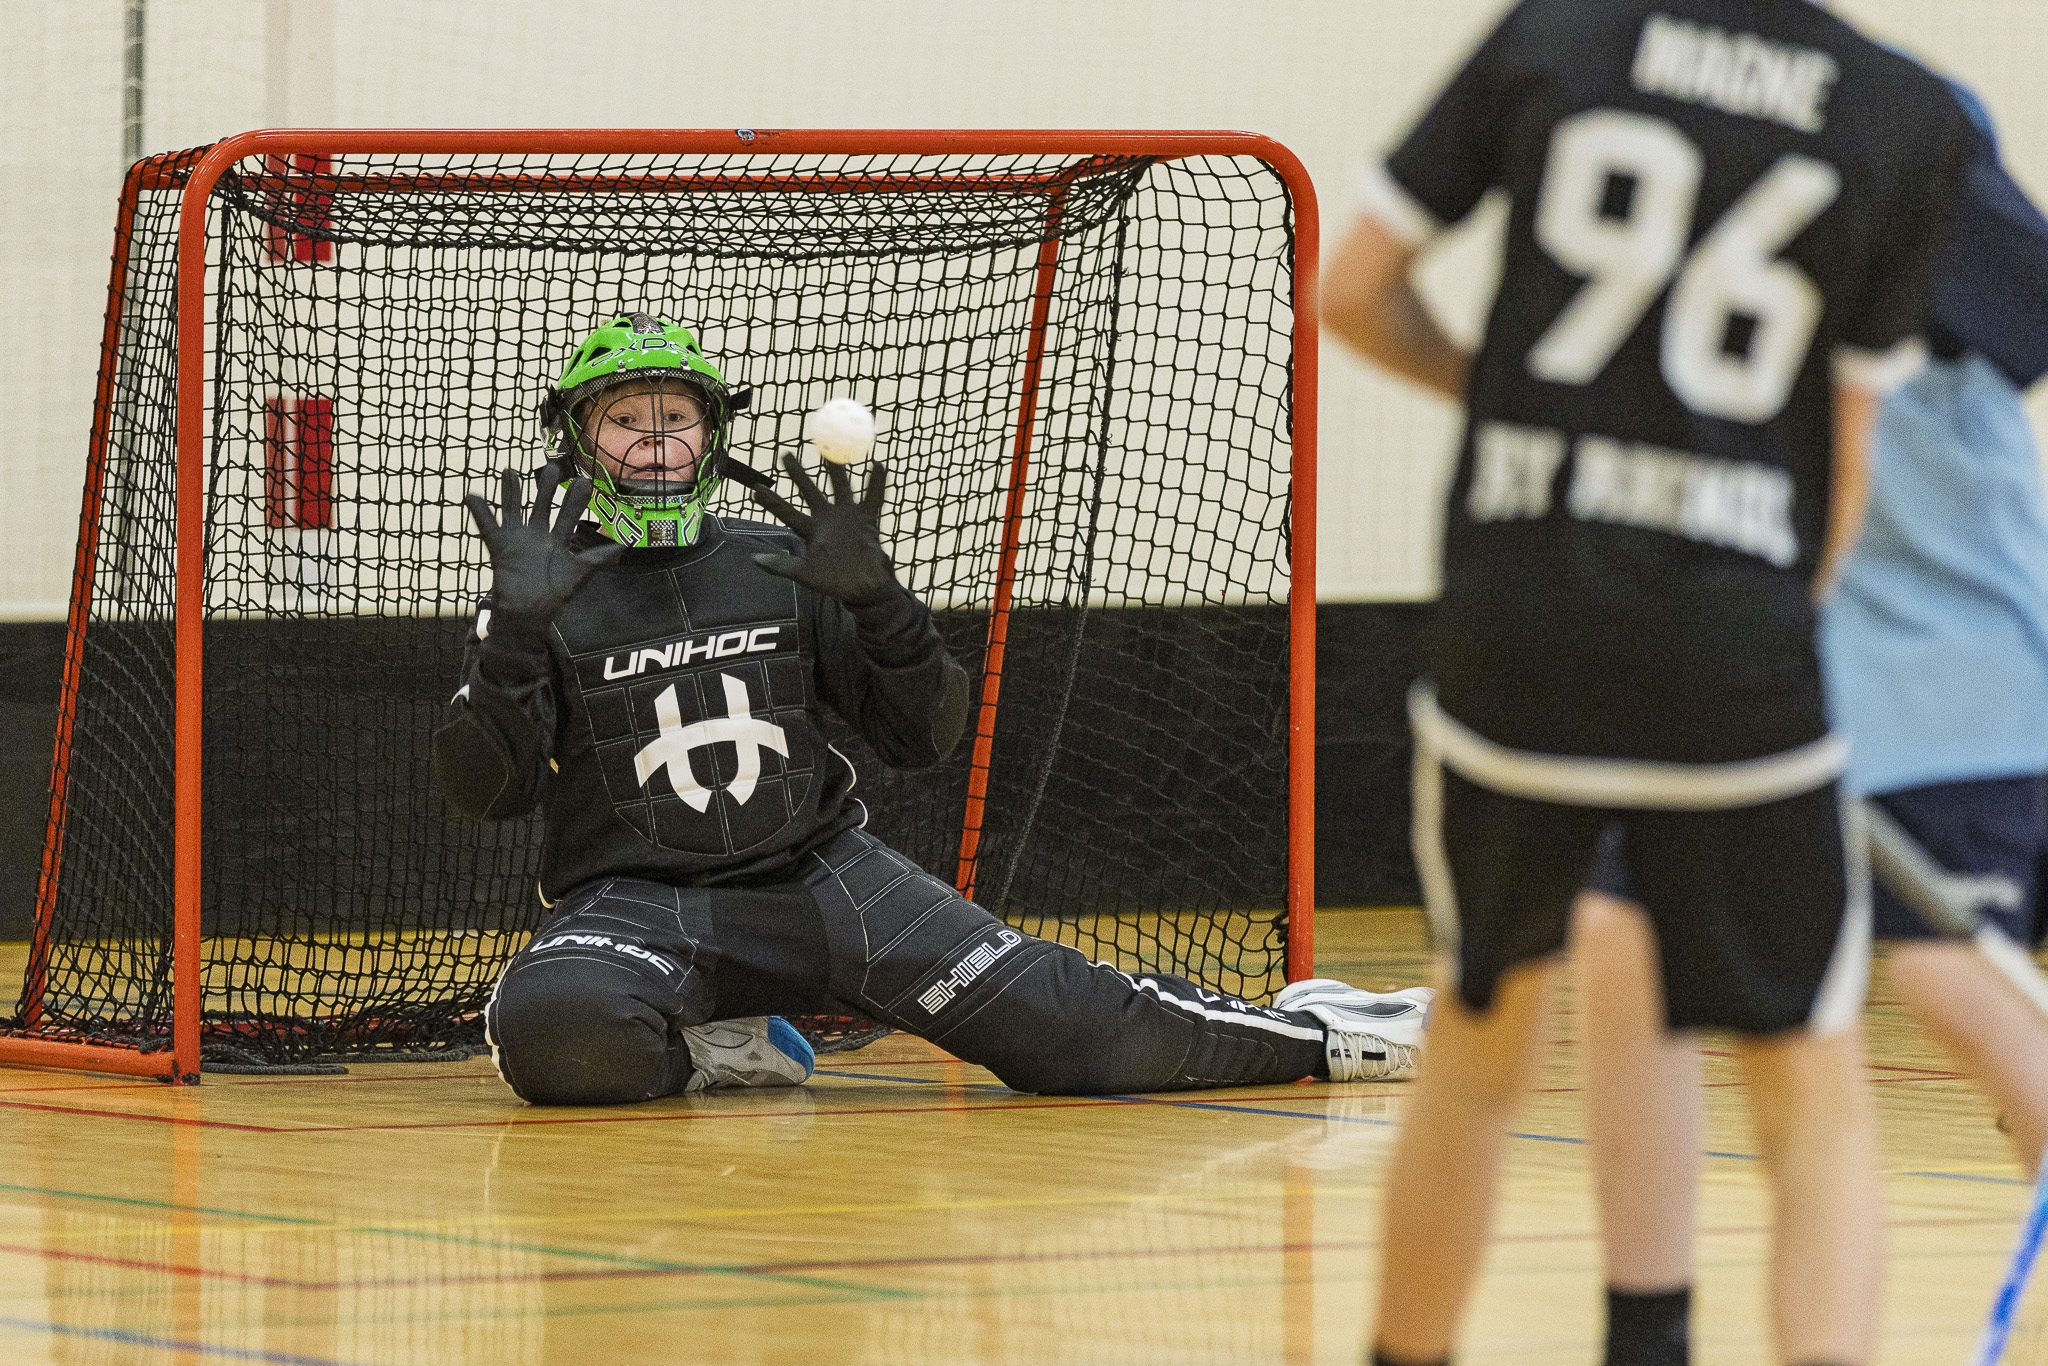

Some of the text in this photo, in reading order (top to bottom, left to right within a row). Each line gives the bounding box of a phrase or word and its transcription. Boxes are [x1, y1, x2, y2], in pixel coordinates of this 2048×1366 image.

[1524, 106, 1841, 424] 96
[603, 626, 780, 681] UNIHOC
[918, 929, 1023, 1015] SHIELD
